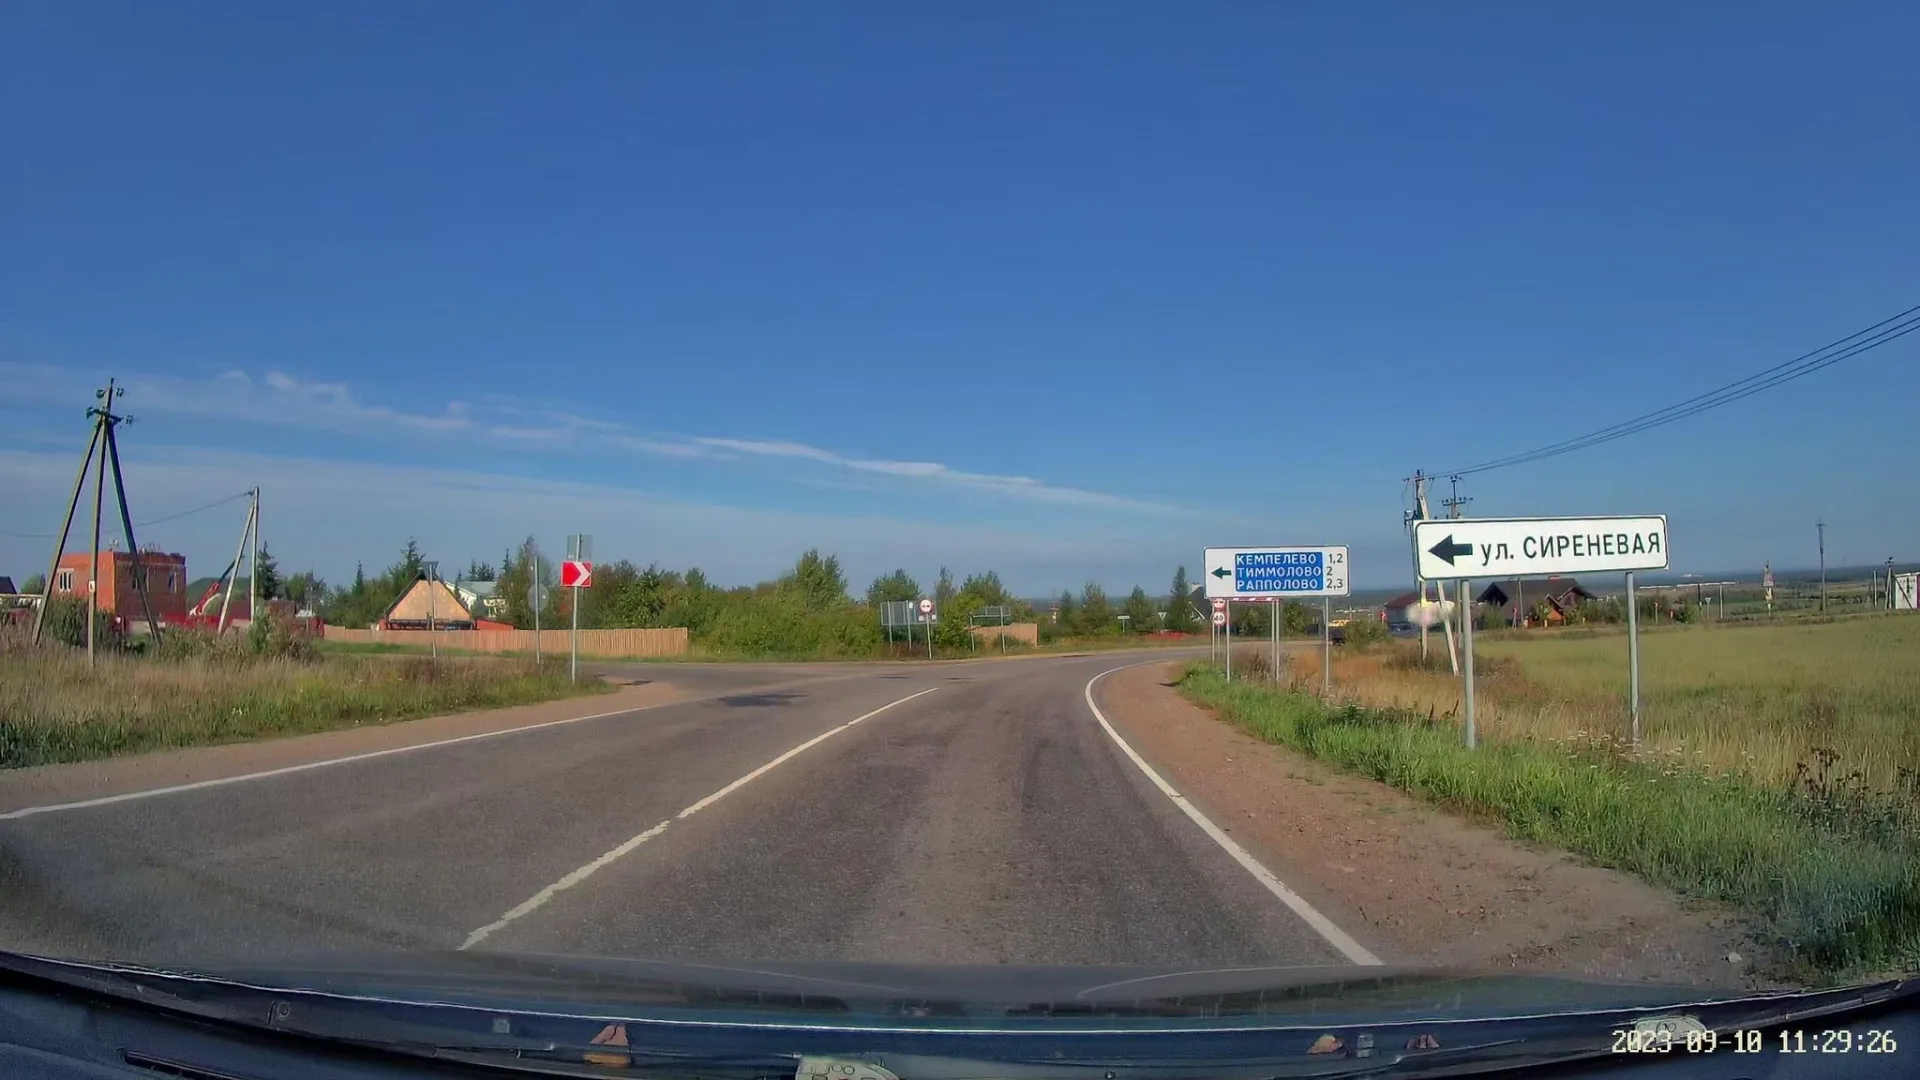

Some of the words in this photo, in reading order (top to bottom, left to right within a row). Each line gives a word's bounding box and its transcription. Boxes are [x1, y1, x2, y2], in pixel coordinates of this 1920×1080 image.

[1481, 543, 1514, 566] ул.
[1523, 532, 1661, 559] СИРЕНЕВАЯ
[1236, 554, 1316, 565] КЕМПЕЛЕВО
[1328, 553, 1343, 564] 1,2
[1237, 566, 1322, 577] ТИММОЛОВО
[1326, 566, 1333, 576] 2
[1237, 579, 1318, 590] РАППОЛОВО
[1326, 579, 1344, 589] 2,3
